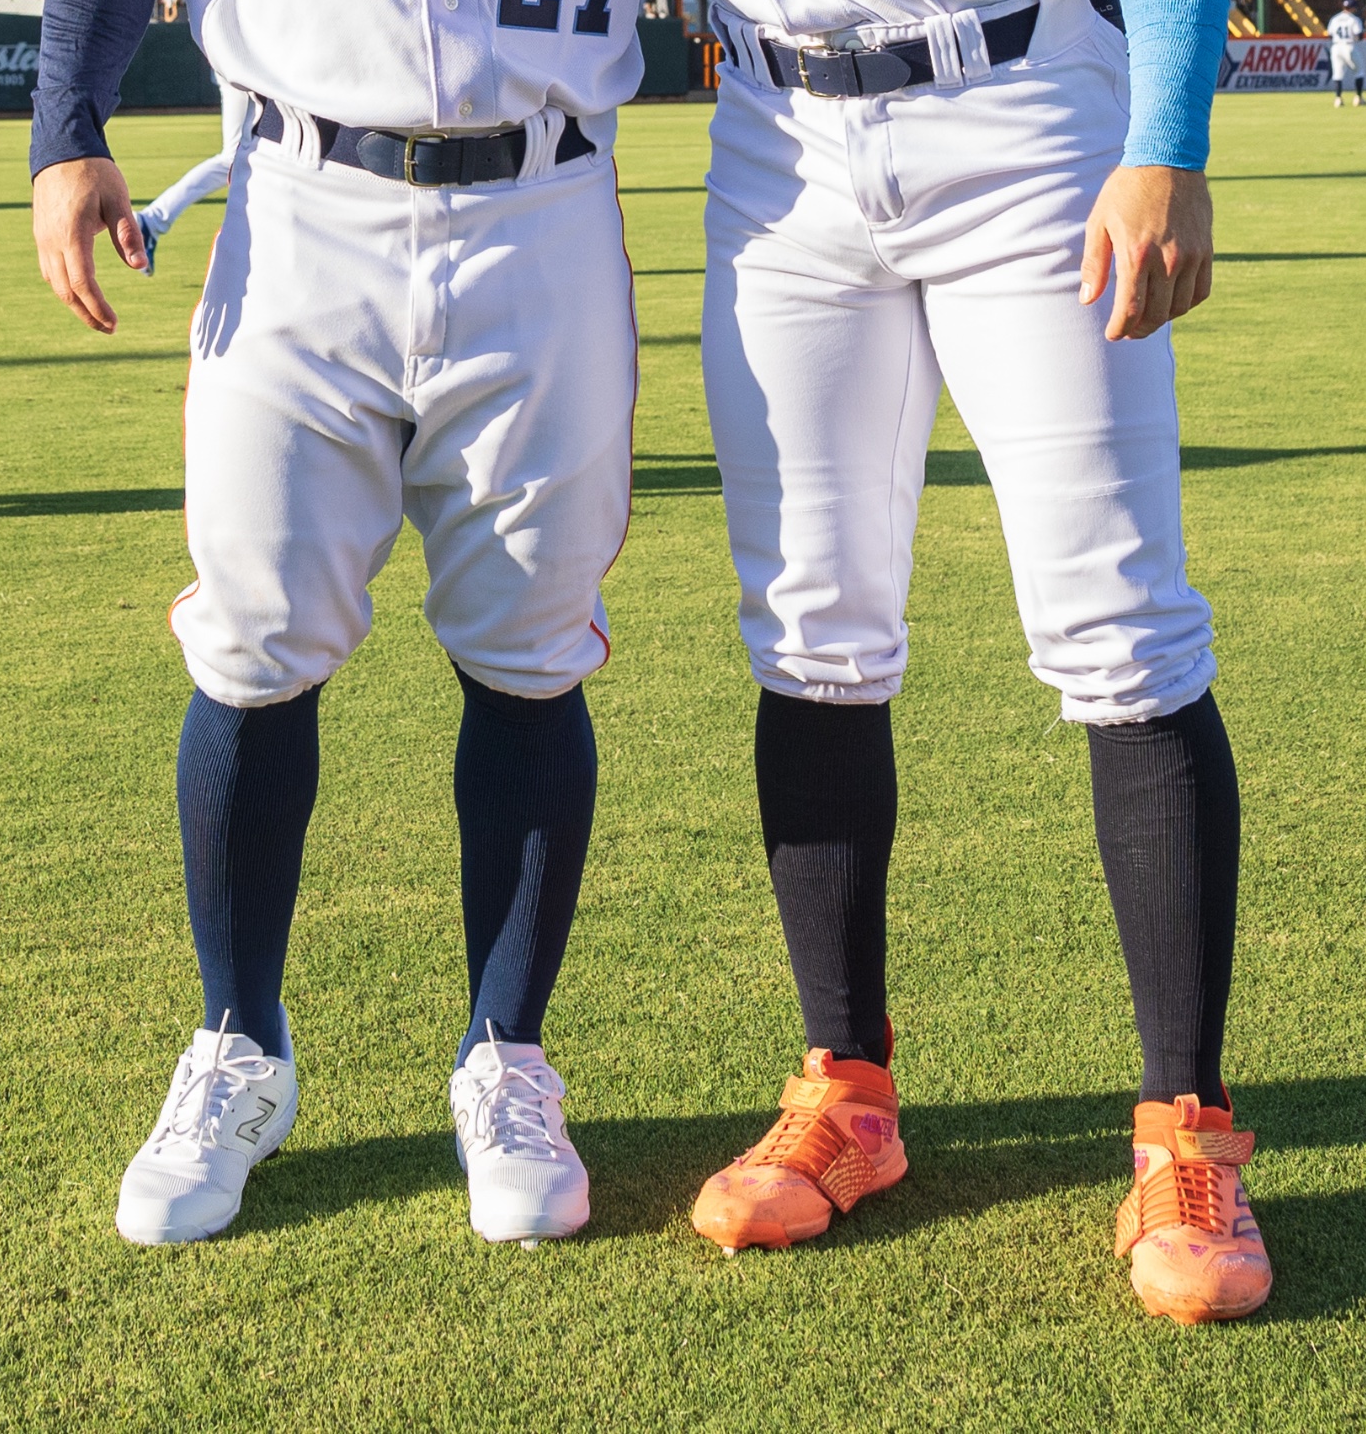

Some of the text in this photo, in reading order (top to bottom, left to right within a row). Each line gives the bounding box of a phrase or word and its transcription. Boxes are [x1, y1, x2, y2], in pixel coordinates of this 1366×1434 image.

[1336, 26, 1350, 39] 41
[1240, 44, 1321, 73] ARROW
[1235, 73, 1321, 89] EXTERMINATORS
